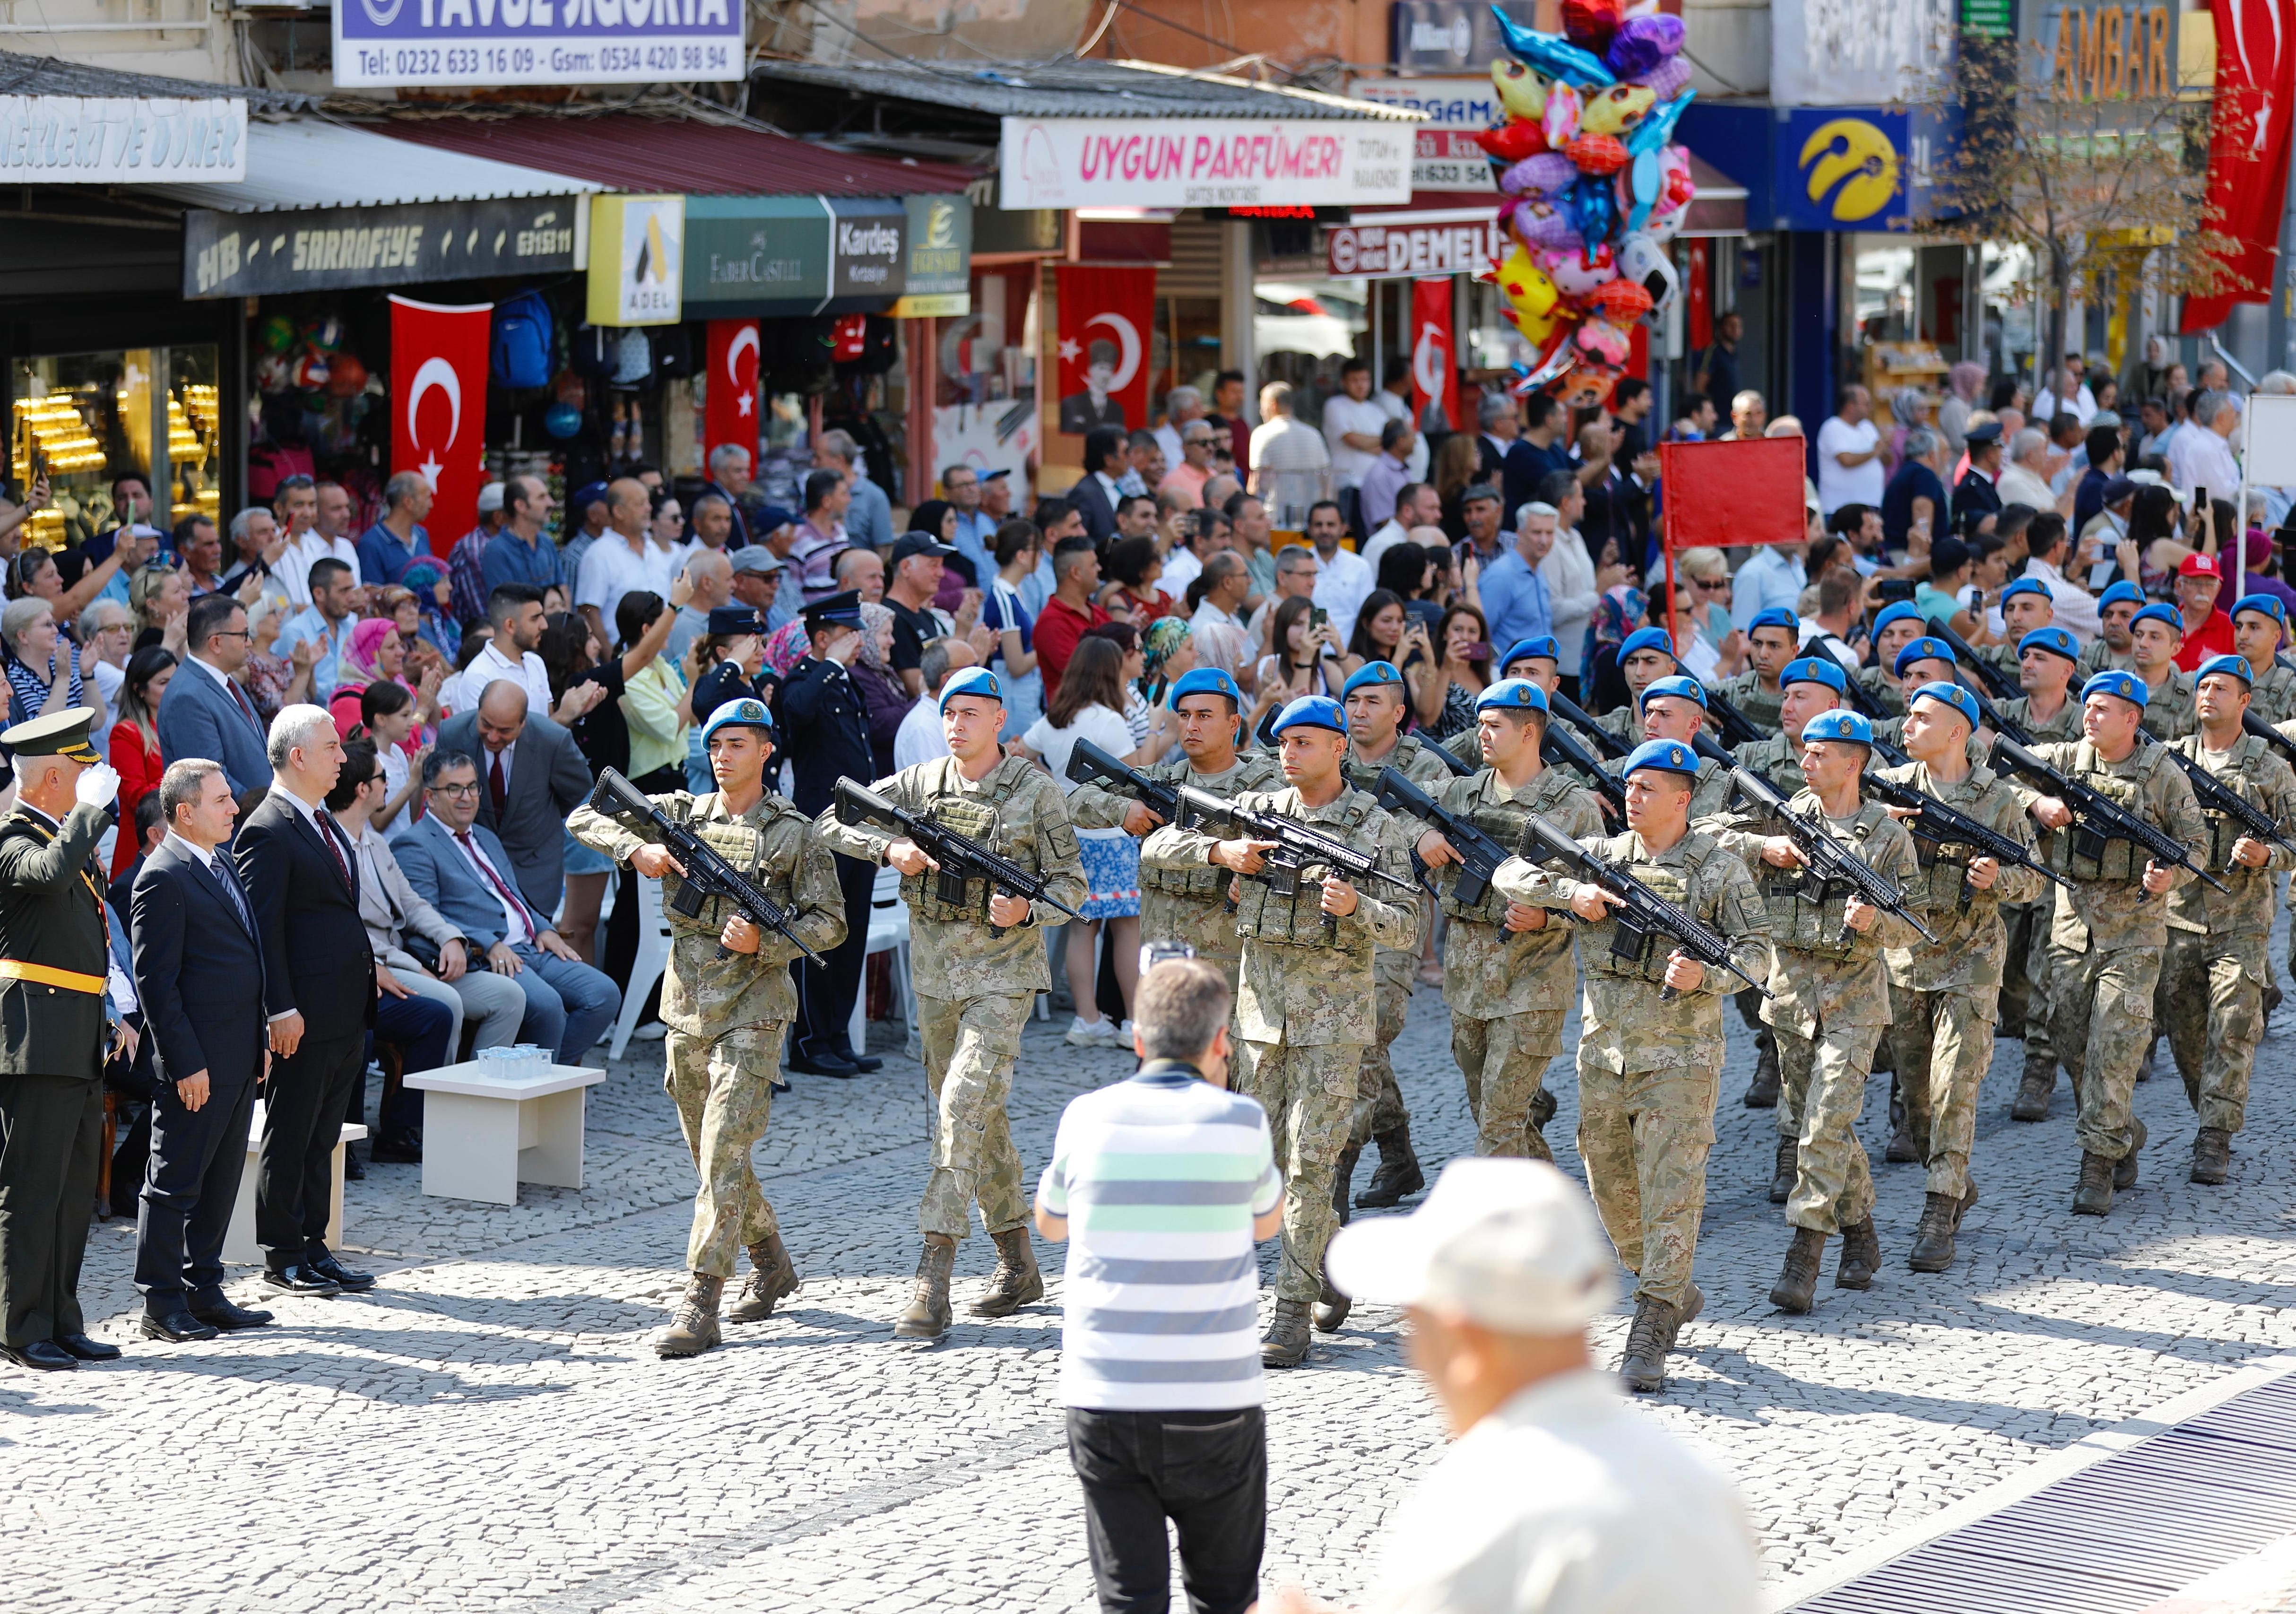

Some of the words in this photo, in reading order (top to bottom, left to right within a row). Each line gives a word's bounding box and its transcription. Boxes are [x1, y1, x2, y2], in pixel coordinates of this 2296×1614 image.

[359, 48, 390, 75] Tel:
[398, 48, 441, 74] 0232
[448, 48, 478, 74] 633
[487, 48, 507, 73] 16
[514, 48, 534, 73] 09
[552, 48, 594, 71] Gsm:
[600, 46, 641, 71] 0534
[647, 46, 678, 70] 420
[683, 46, 703, 70] 98
[709, 46, 727, 69] 94
[2053, 5, 2169, 100] AMBAR
[1081, 135, 1186, 182] UYGUN
[1191, 124, 1345, 179] PARFÜMERİ
[197, 231, 240, 293] HB
[839, 222, 899, 263] Kardeş
[631, 291, 669, 310] ADEL
